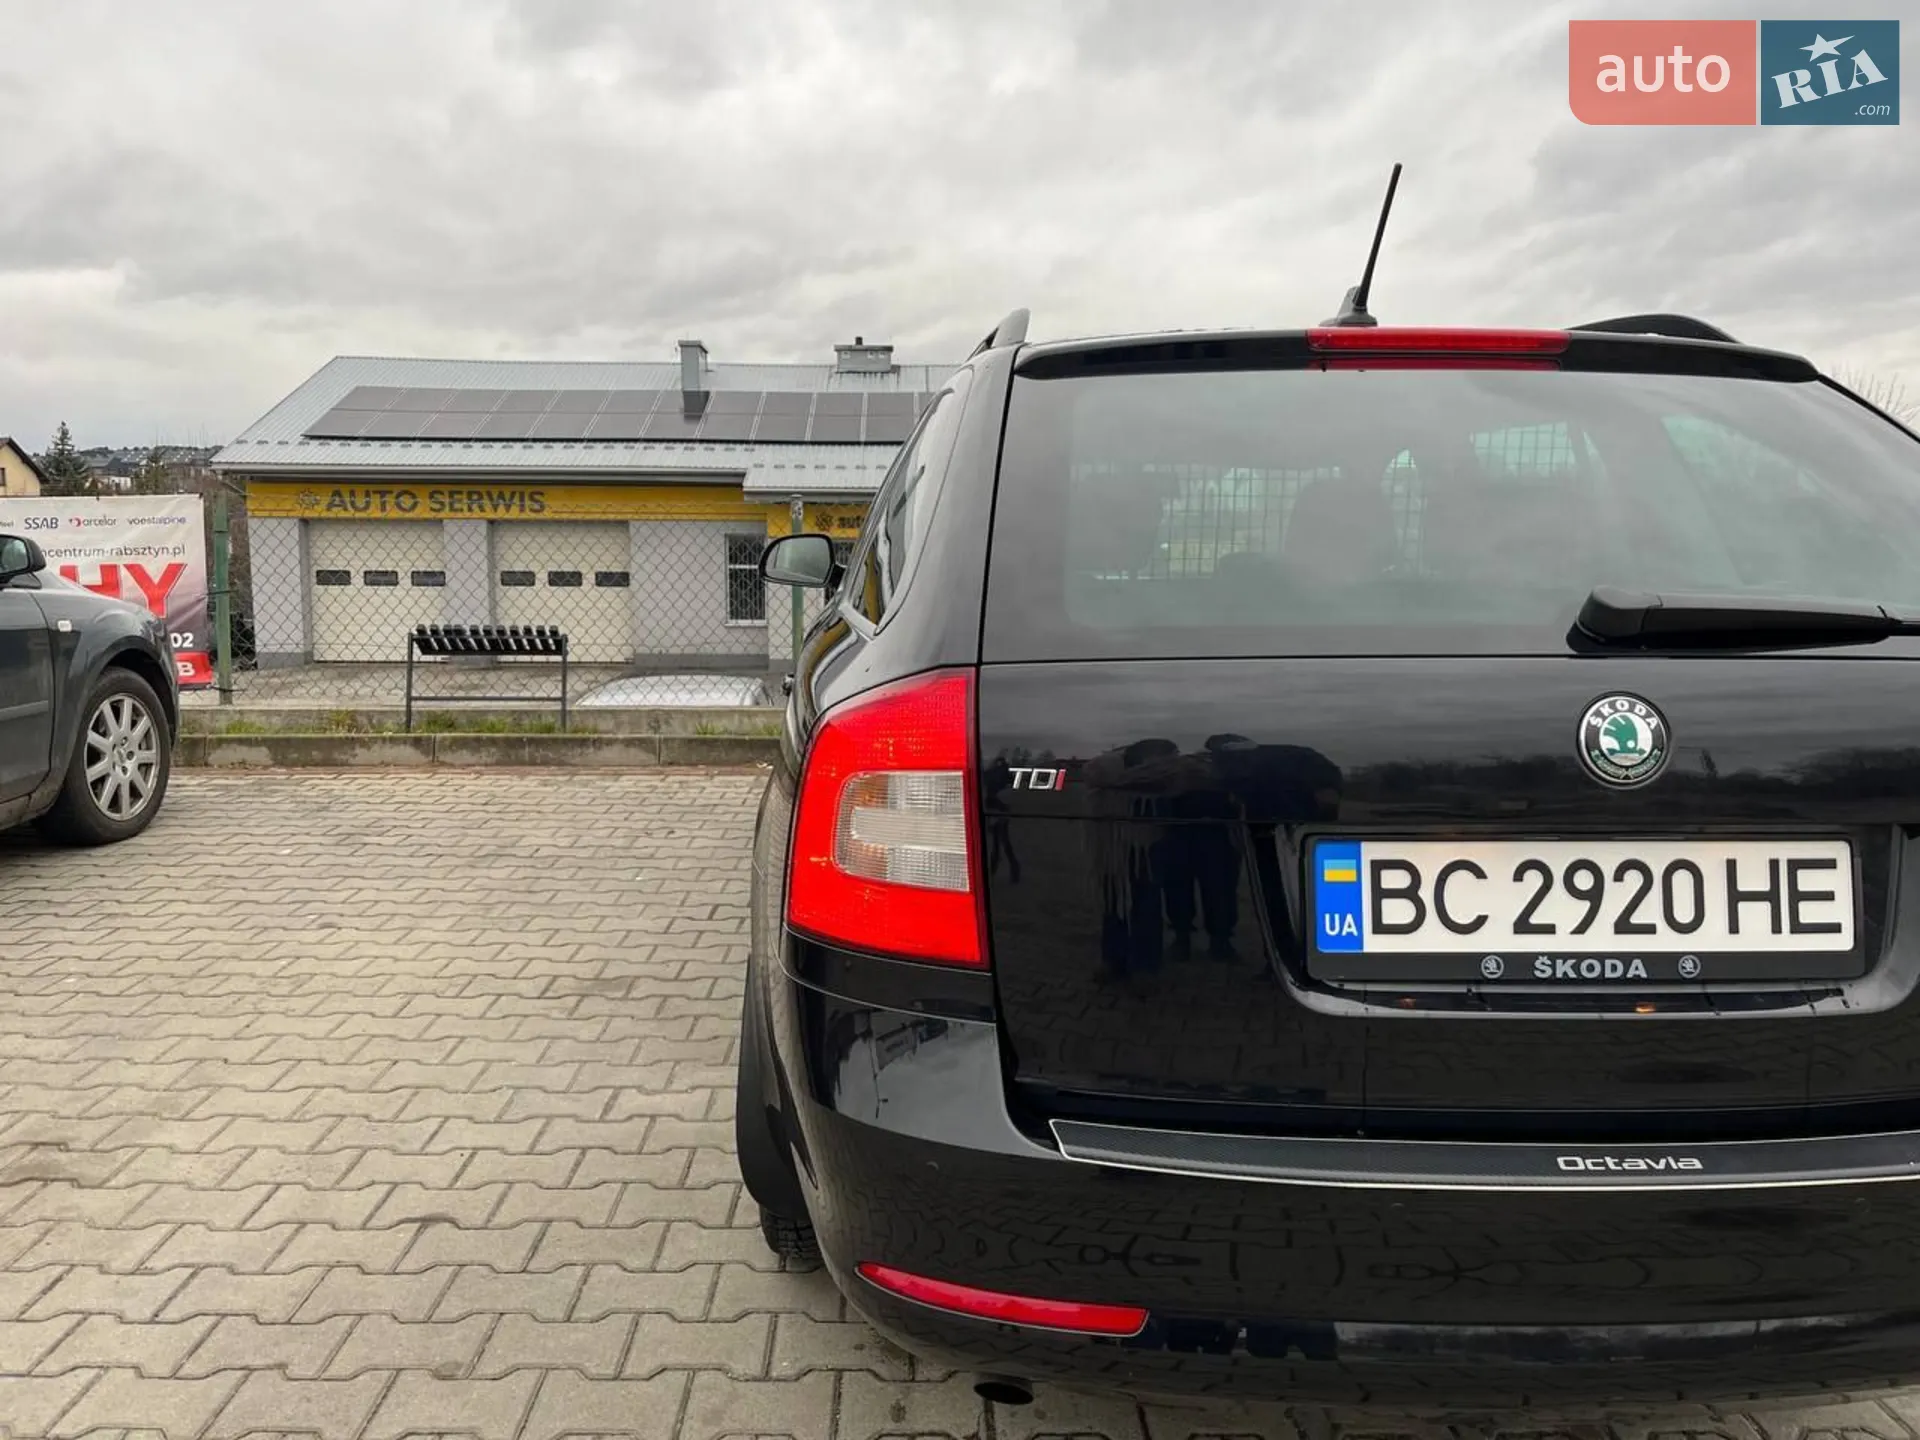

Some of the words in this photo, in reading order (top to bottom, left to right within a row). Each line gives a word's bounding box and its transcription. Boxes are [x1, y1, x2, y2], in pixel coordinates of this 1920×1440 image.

[325, 489, 420, 513] AUTO
[429, 489, 546, 513] SERWIS
[24, 516, 60, 530] SSAB
[1325, 912, 1358, 936] UA
[1370, 859, 1489, 935] BC
[1512, 858, 1706, 935] 2920
[1725, 858, 1842, 935] HE
[1556, 1155, 1703, 1171] Octavia
